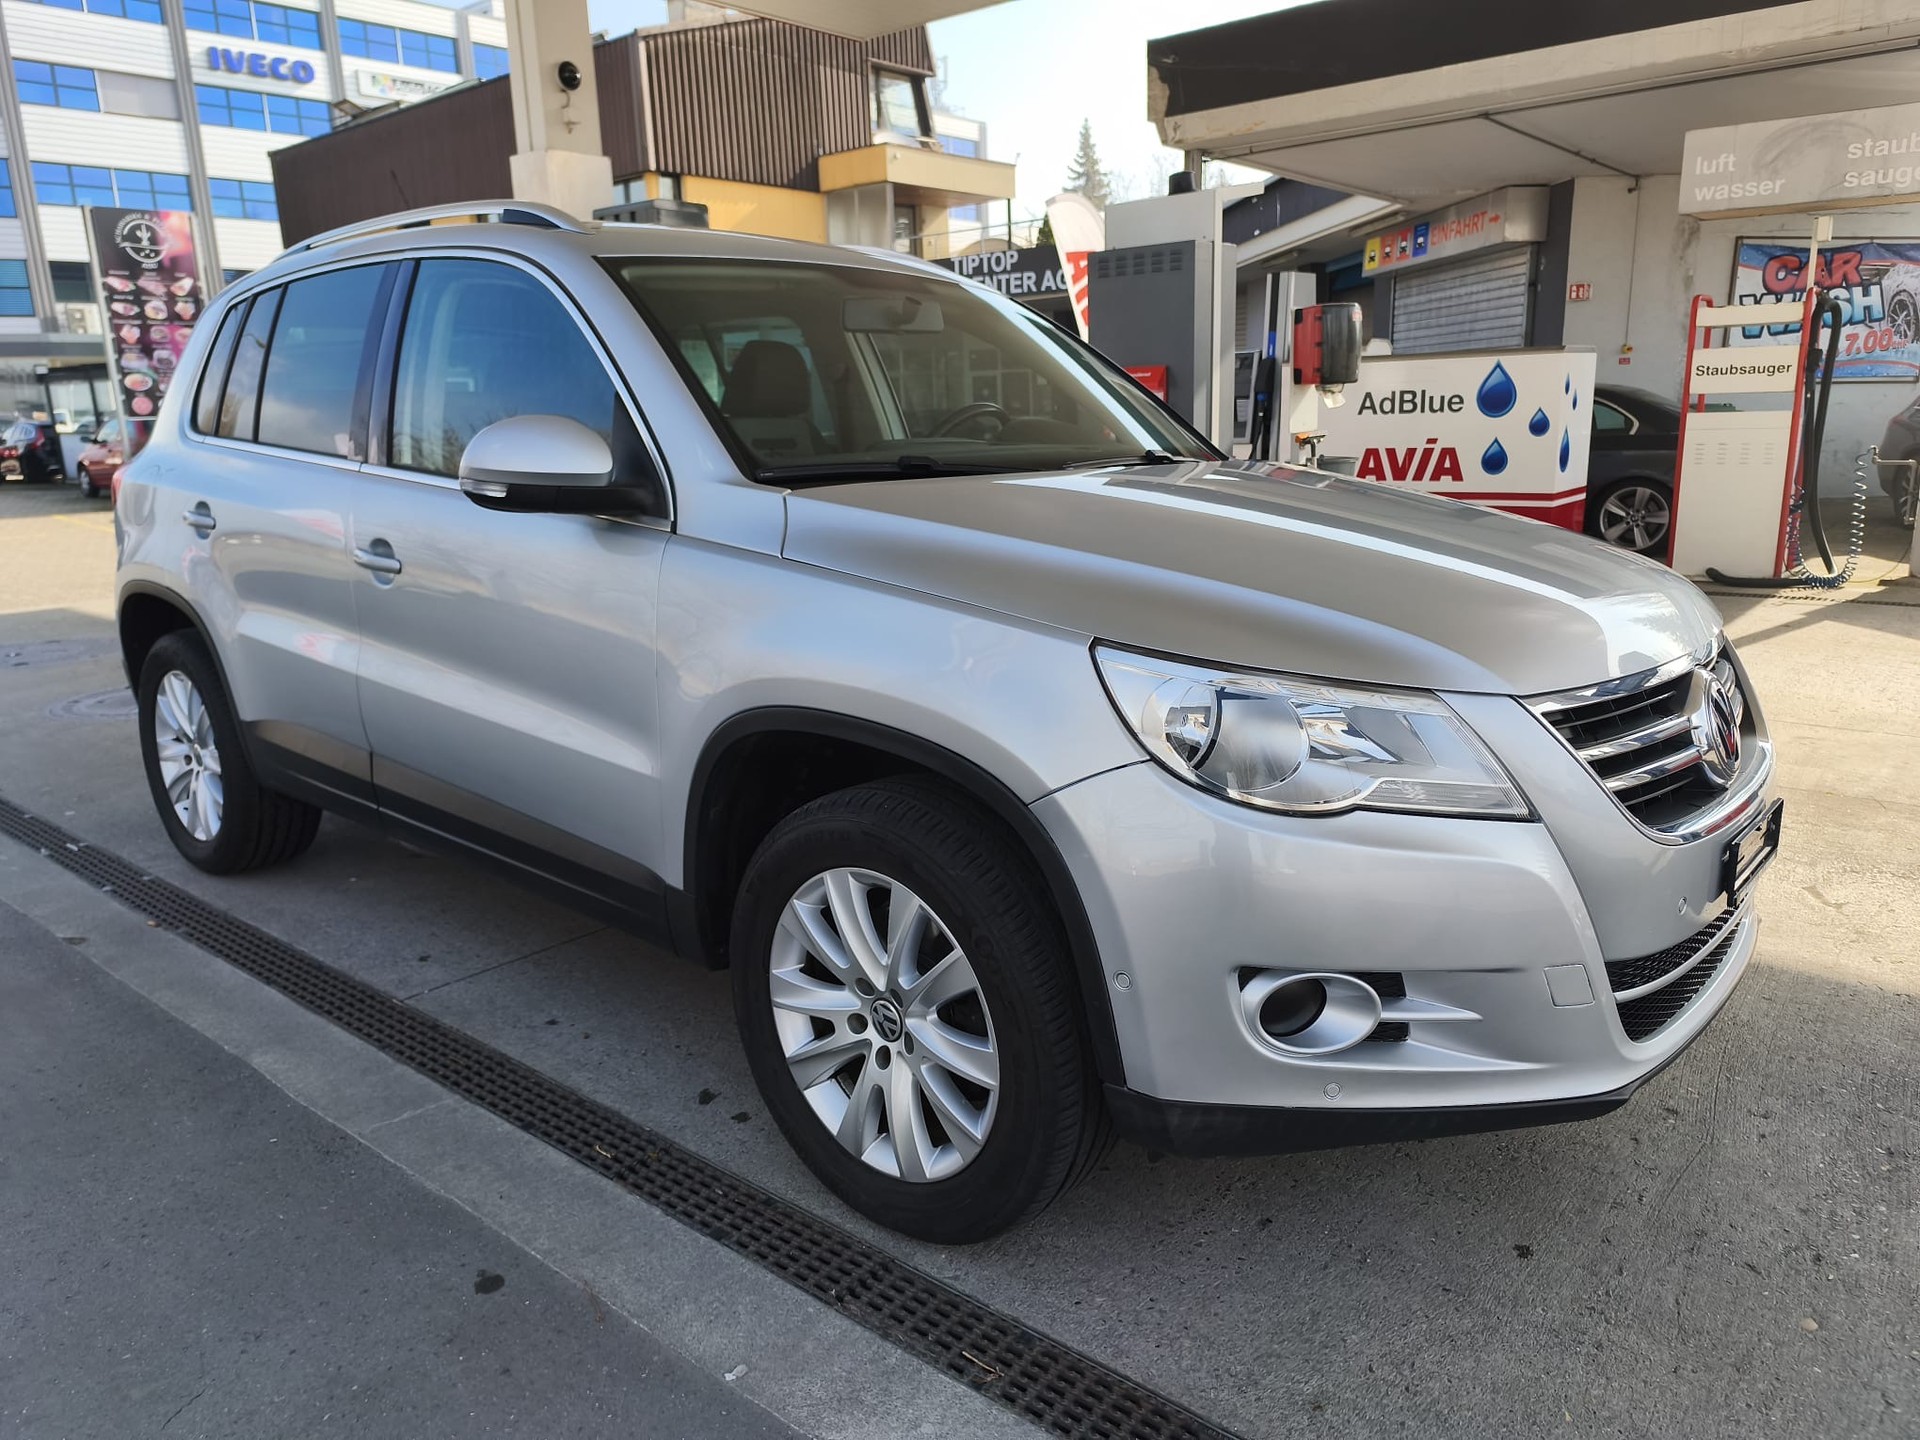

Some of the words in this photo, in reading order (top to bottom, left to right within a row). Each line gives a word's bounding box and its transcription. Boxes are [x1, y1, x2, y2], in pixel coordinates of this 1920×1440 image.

[208, 46, 315, 84] IVECO
[1695, 153, 1736, 175] luft
[1694, 178, 1785, 201] wasser
[1430, 210, 1488, 246] EINFAHRT
[951, 250, 1019, 276] TIPTOP
[1762, 251, 1863, 293] CAR
[1845, 328, 1894, 356] 7.00
[1695, 364, 1792, 376] Staubsauger
[1357, 389, 1465, 415] AdBlue
